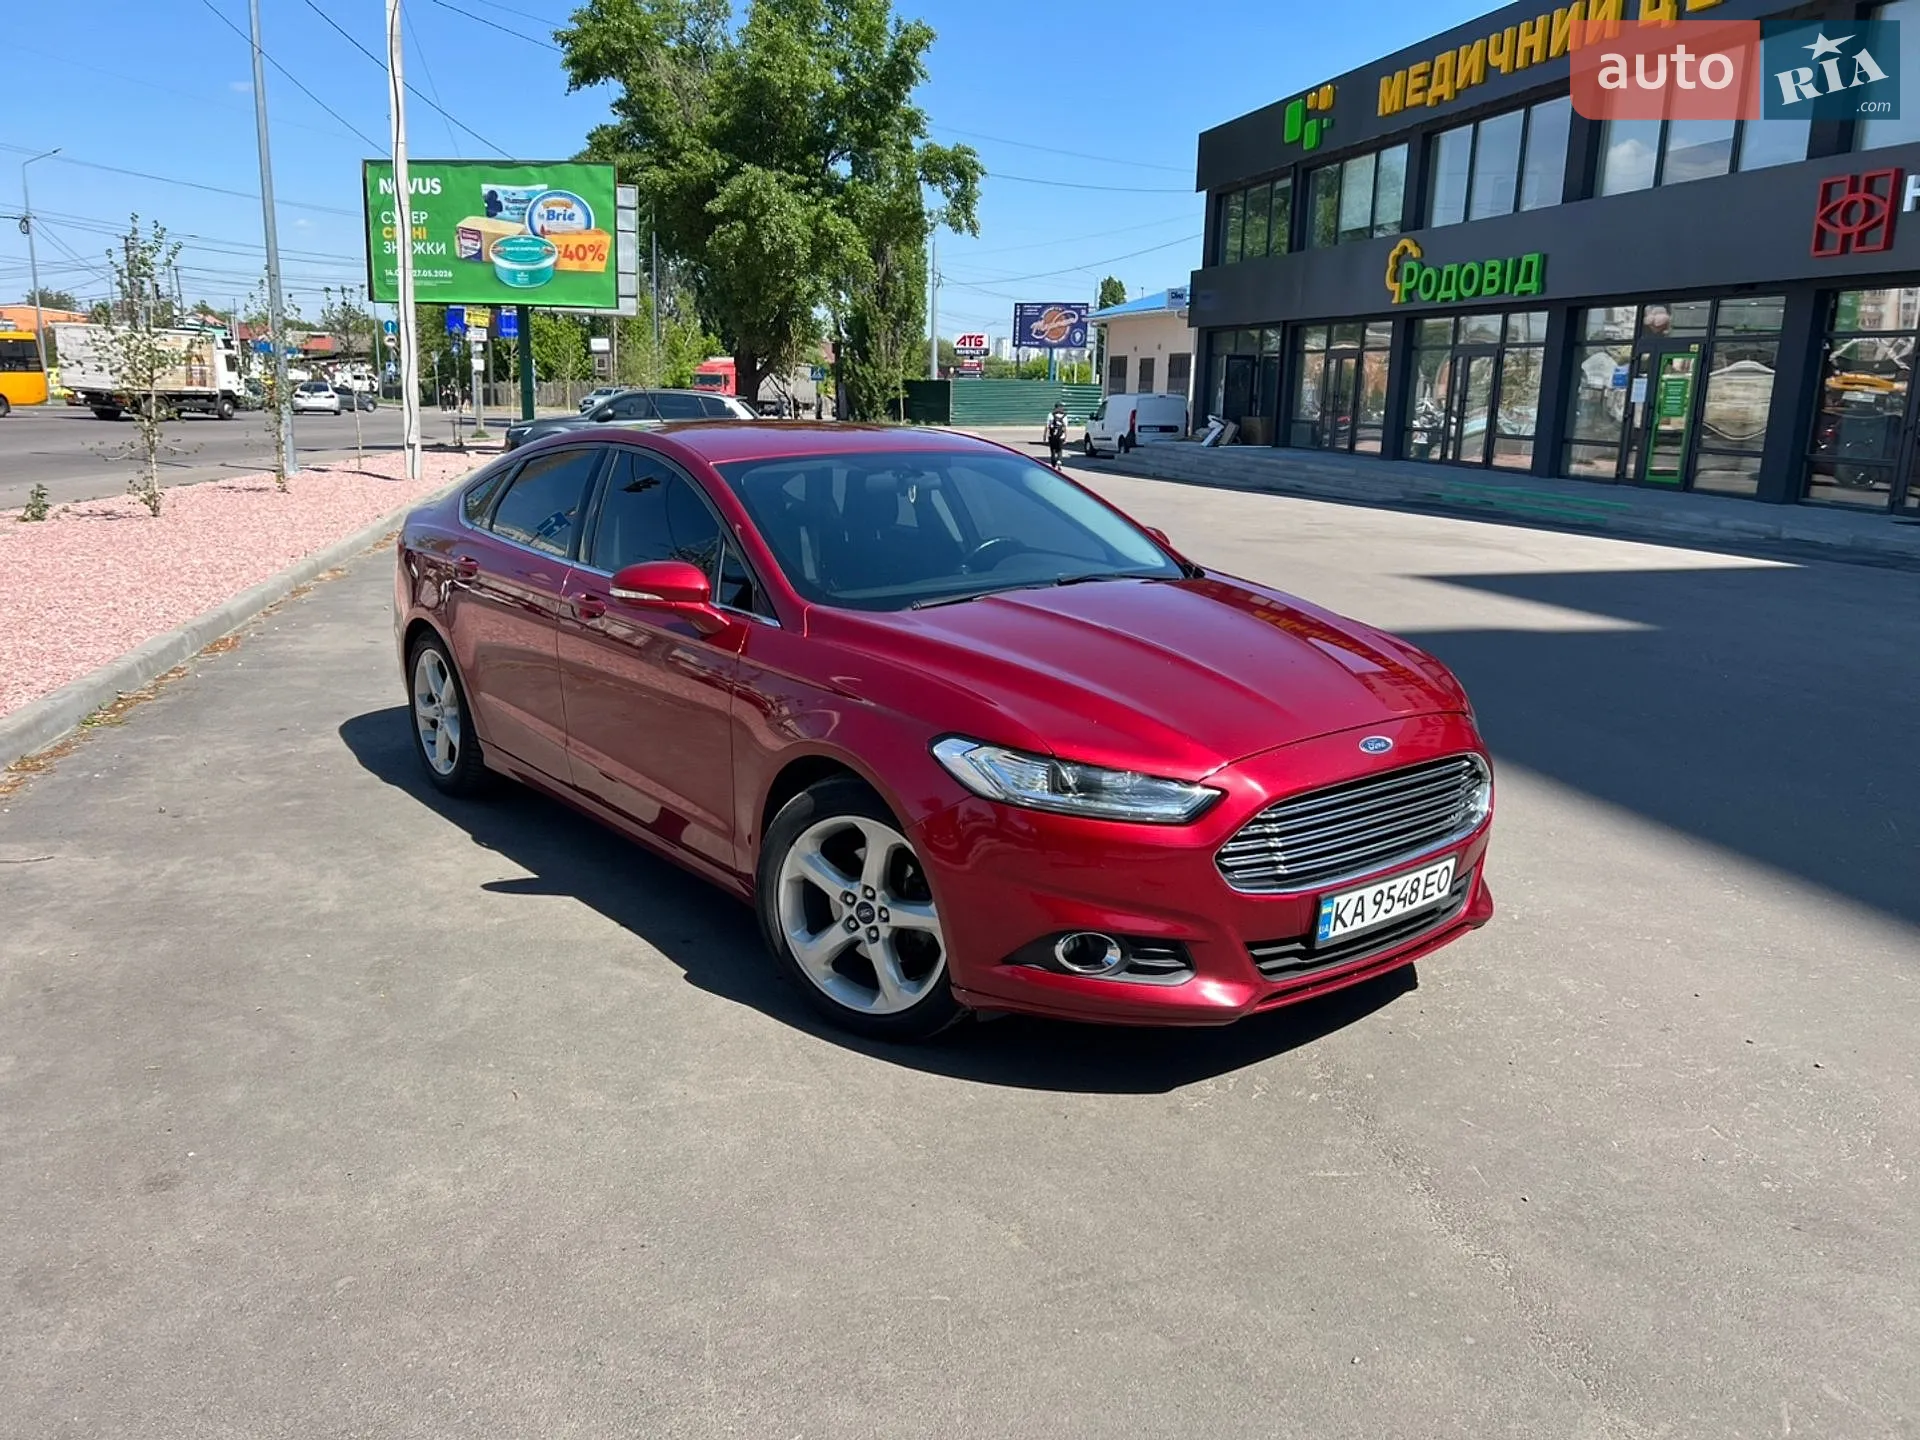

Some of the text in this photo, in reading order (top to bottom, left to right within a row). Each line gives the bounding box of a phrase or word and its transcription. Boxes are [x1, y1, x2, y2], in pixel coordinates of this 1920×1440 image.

[379, 178, 442, 194] NVUS
[546, 209, 576, 221] Brie
[383, 241, 446, 255] ЗНЖКИ
[1332, 895, 1366, 932] KA
[1371, 877, 1421, 920] 9548
